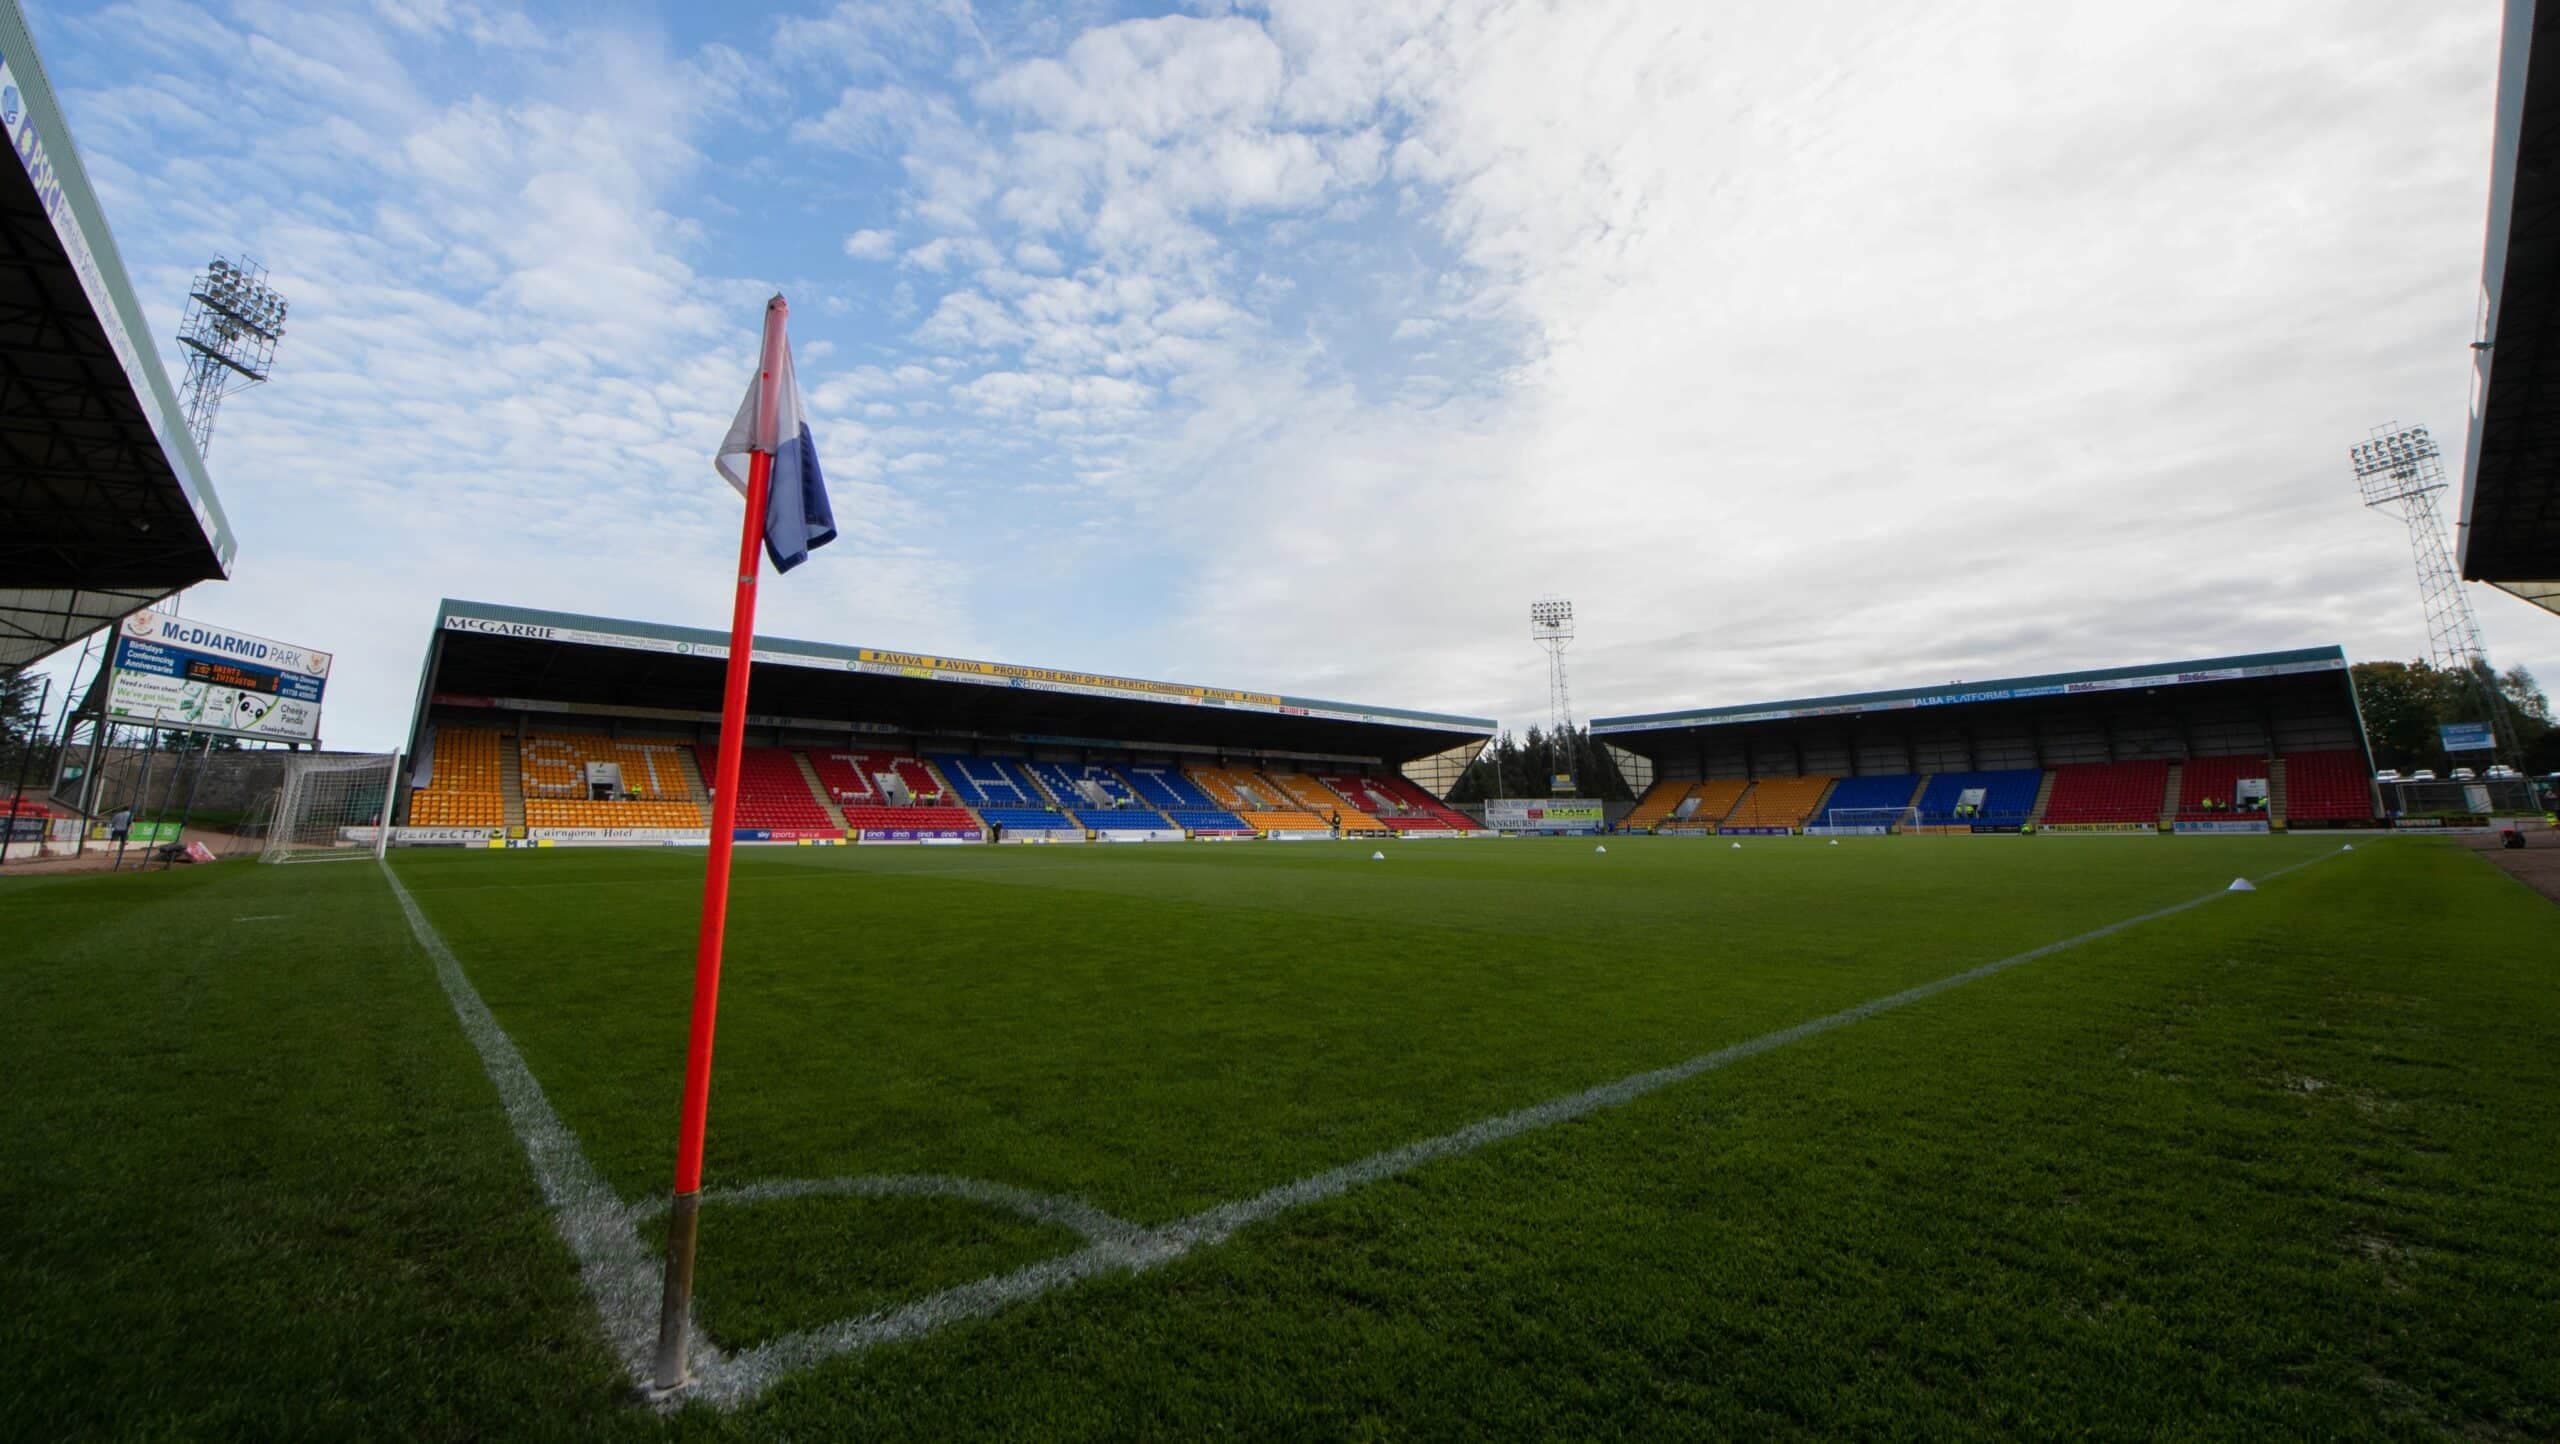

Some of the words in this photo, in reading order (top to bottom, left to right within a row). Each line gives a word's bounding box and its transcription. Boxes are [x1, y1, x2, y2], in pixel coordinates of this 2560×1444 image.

[28, 140, 60, 214] PSPC
[446, 617, 557, 639] McGARRIE
[129, 641, 164, 655] Birthdays
[162, 621, 267, 659] McDIARMID
[269, 647, 302, 668] PARK
[127, 650, 175, 666] Conferencing
[125, 659, 174, 675] Anniversaries
[885, 653, 923, 665] AVIVA
[945, 660, 982, 673] AVIVA
[993, 665, 1029, 676] PROUD
[1032, 670, 1043, 678] TO
[1046, 672, 1057, 680] BE
[1060, 673, 1082, 683] PART
[1085, 676, 1097, 684] OF
[1099, 678, 1115, 686] THE
[1118, 680, 1145, 689] PERTH
[1147, 683, 1195, 695] COMMUNITY
[1211, 689, 1236, 699] AVIVA
[1248, 694, 1273, 704] AVIVA
[1024, 679, 1056, 691] Brown
[1946, 690, 2010, 704] PLATFORMS
[281, 704, 308, 718] Cheeky
[398, 829, 470, 839] PERFECT
[533, 829, 597, 840] Cairngorm
[601, 828, 633, 838] Hotel
[757, 831, 769, 840] sky
[772, 831, 795, 839] sports
[2057, 824, 2092, 833] BUILDING
[2096, 824, 2134, 833] SUPPLIES
